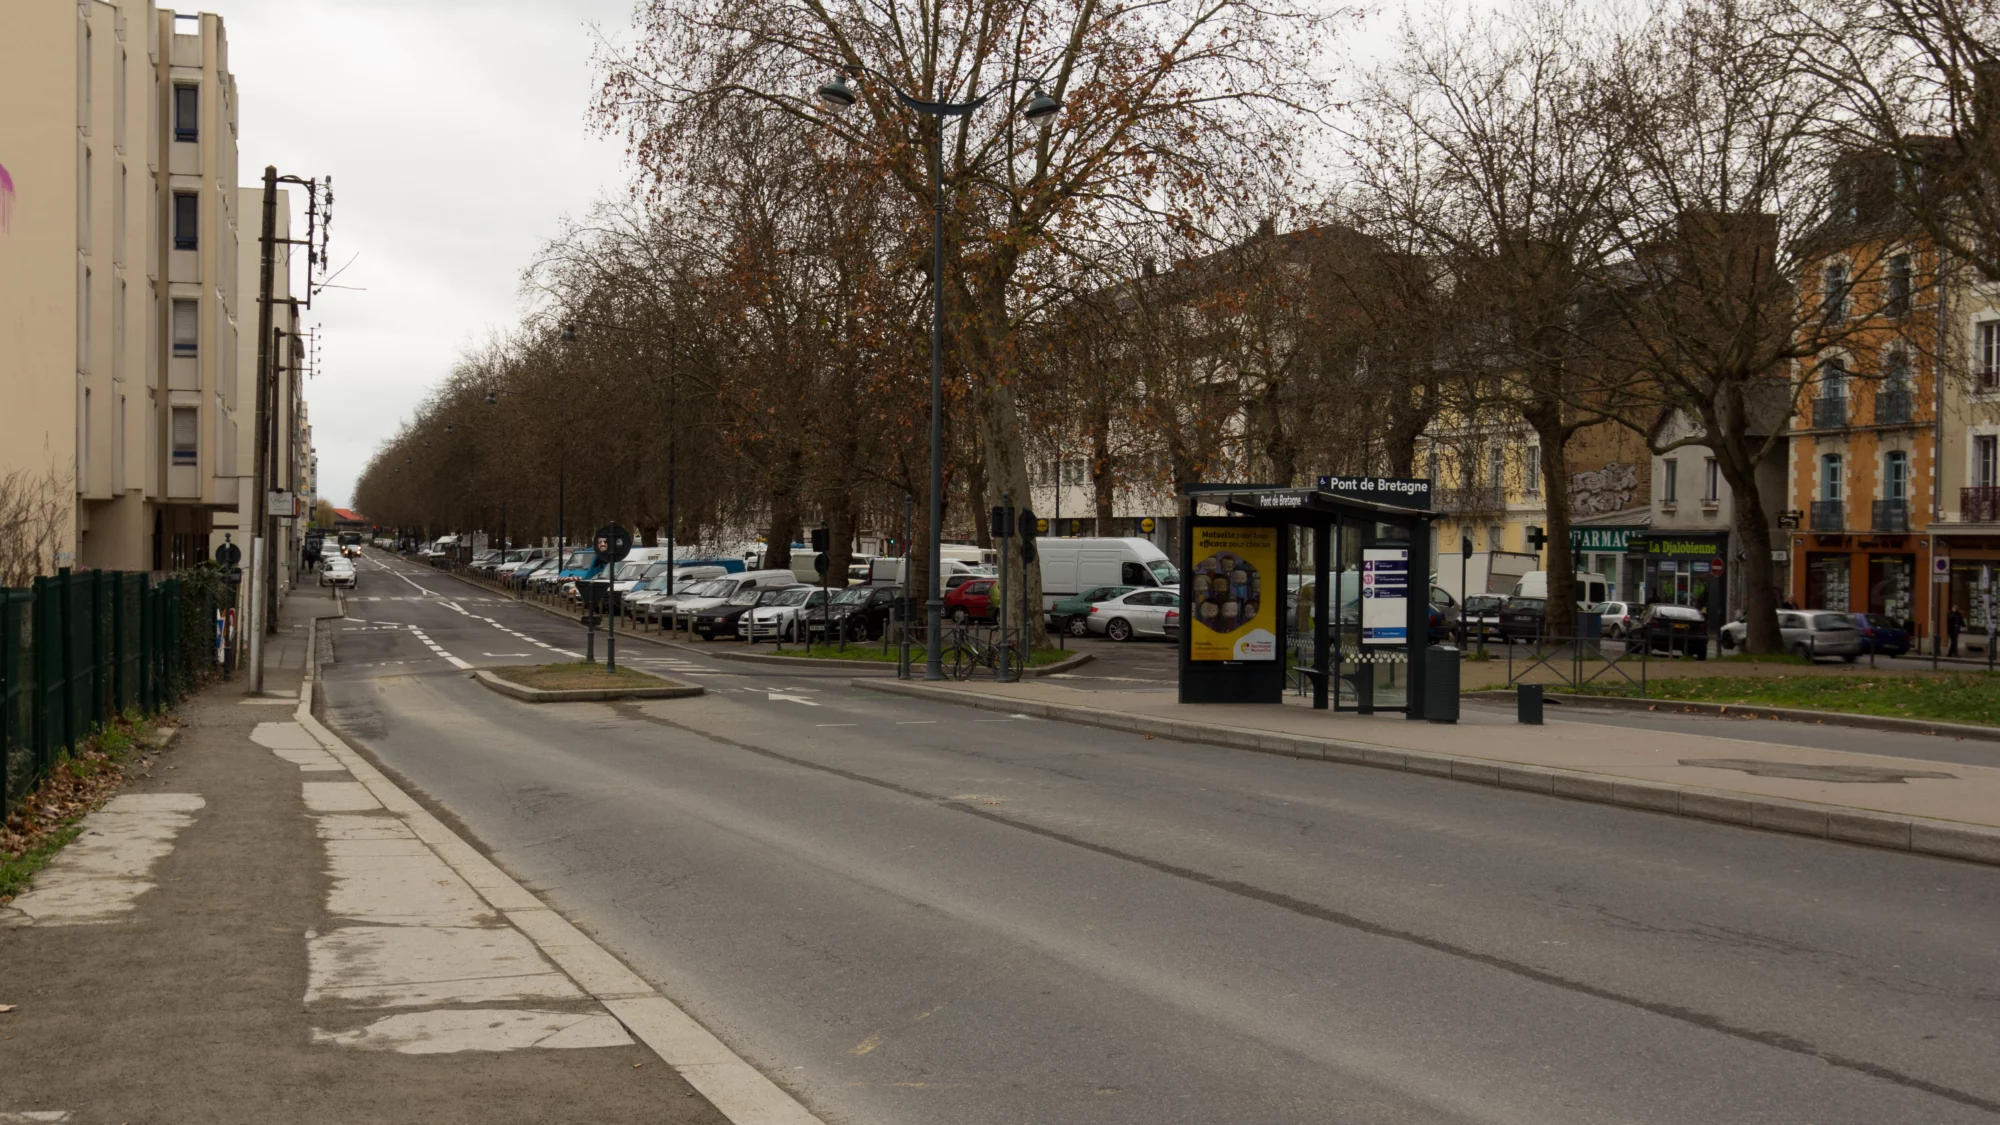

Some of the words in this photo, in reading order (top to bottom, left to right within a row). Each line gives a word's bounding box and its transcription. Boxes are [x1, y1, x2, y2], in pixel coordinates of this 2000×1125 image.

[1330, 477, 1357, 490] Pont
[1360, 477, 1375, 491] de
[1377, 478, 1429, 495] Bretagne
[1260, 495, 1272, 507] Pont
[1272, 495, 1279, 507] de
[1279, 495, 1301, 508] Bretagne
[1237, 532, 1252, 540] pour
[1199, 540, 1227, 548] efficace
[1246, 540, 1271, 548] chacun
[1649, 541, 1660, 553] La
[1661, 540, 1717, 556] Djalobienne
[1365, 561, 1371, 570] 4
